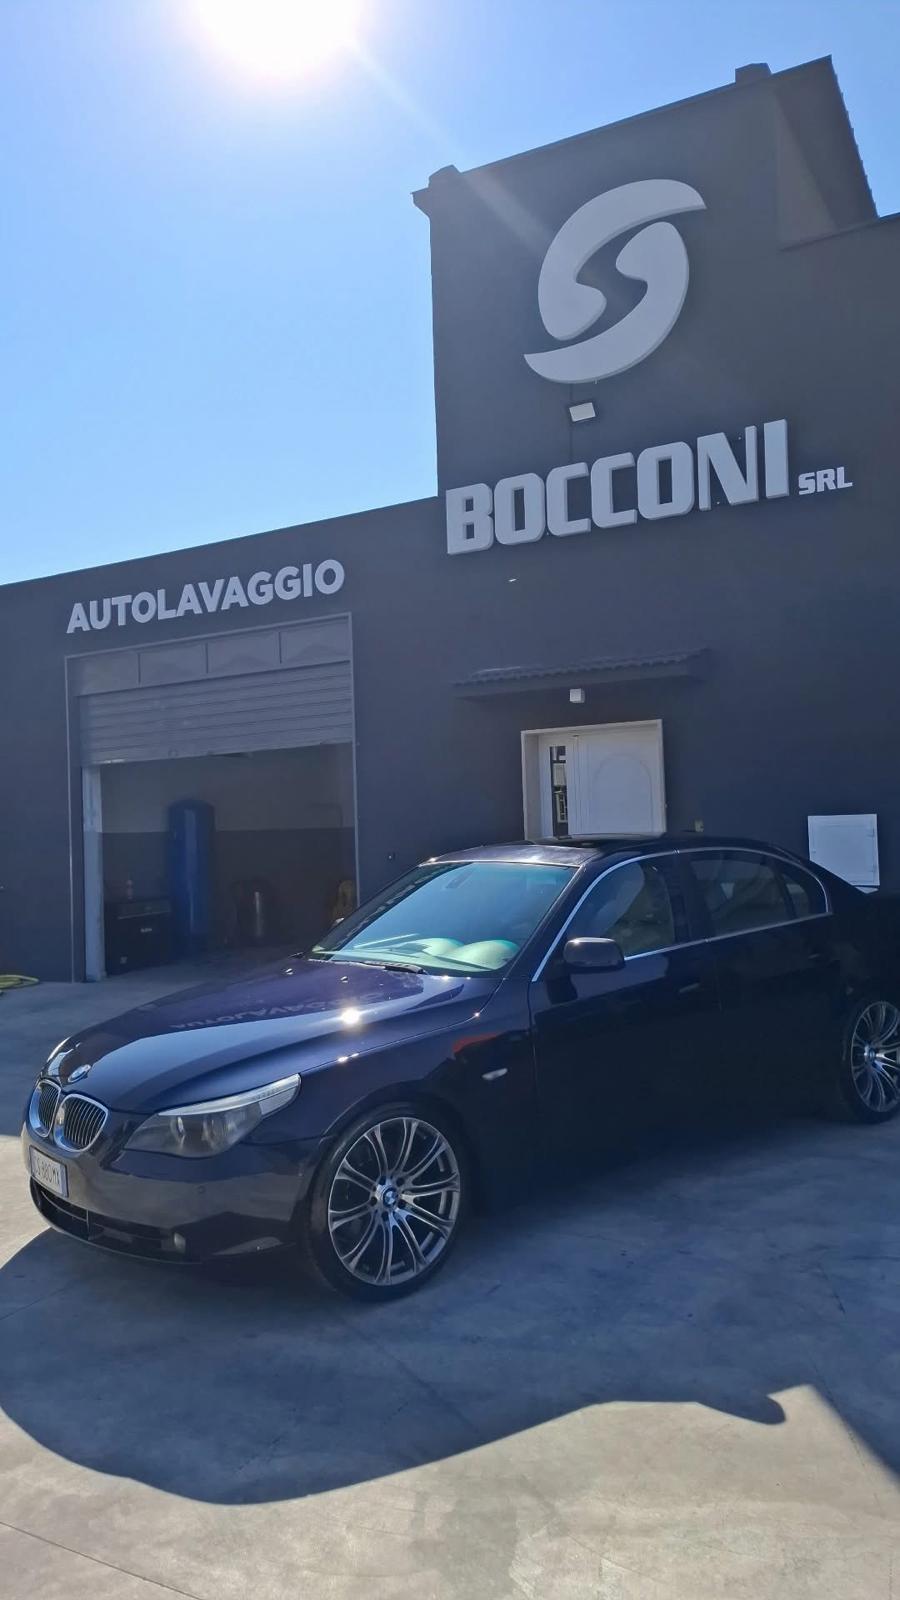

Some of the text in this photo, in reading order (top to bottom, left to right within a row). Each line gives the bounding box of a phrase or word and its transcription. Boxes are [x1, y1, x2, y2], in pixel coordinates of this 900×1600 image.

[445, 418, 853, 555] BOCCONI SRL
[66, 558, 345, 634] AUTOLAVAGGIO
